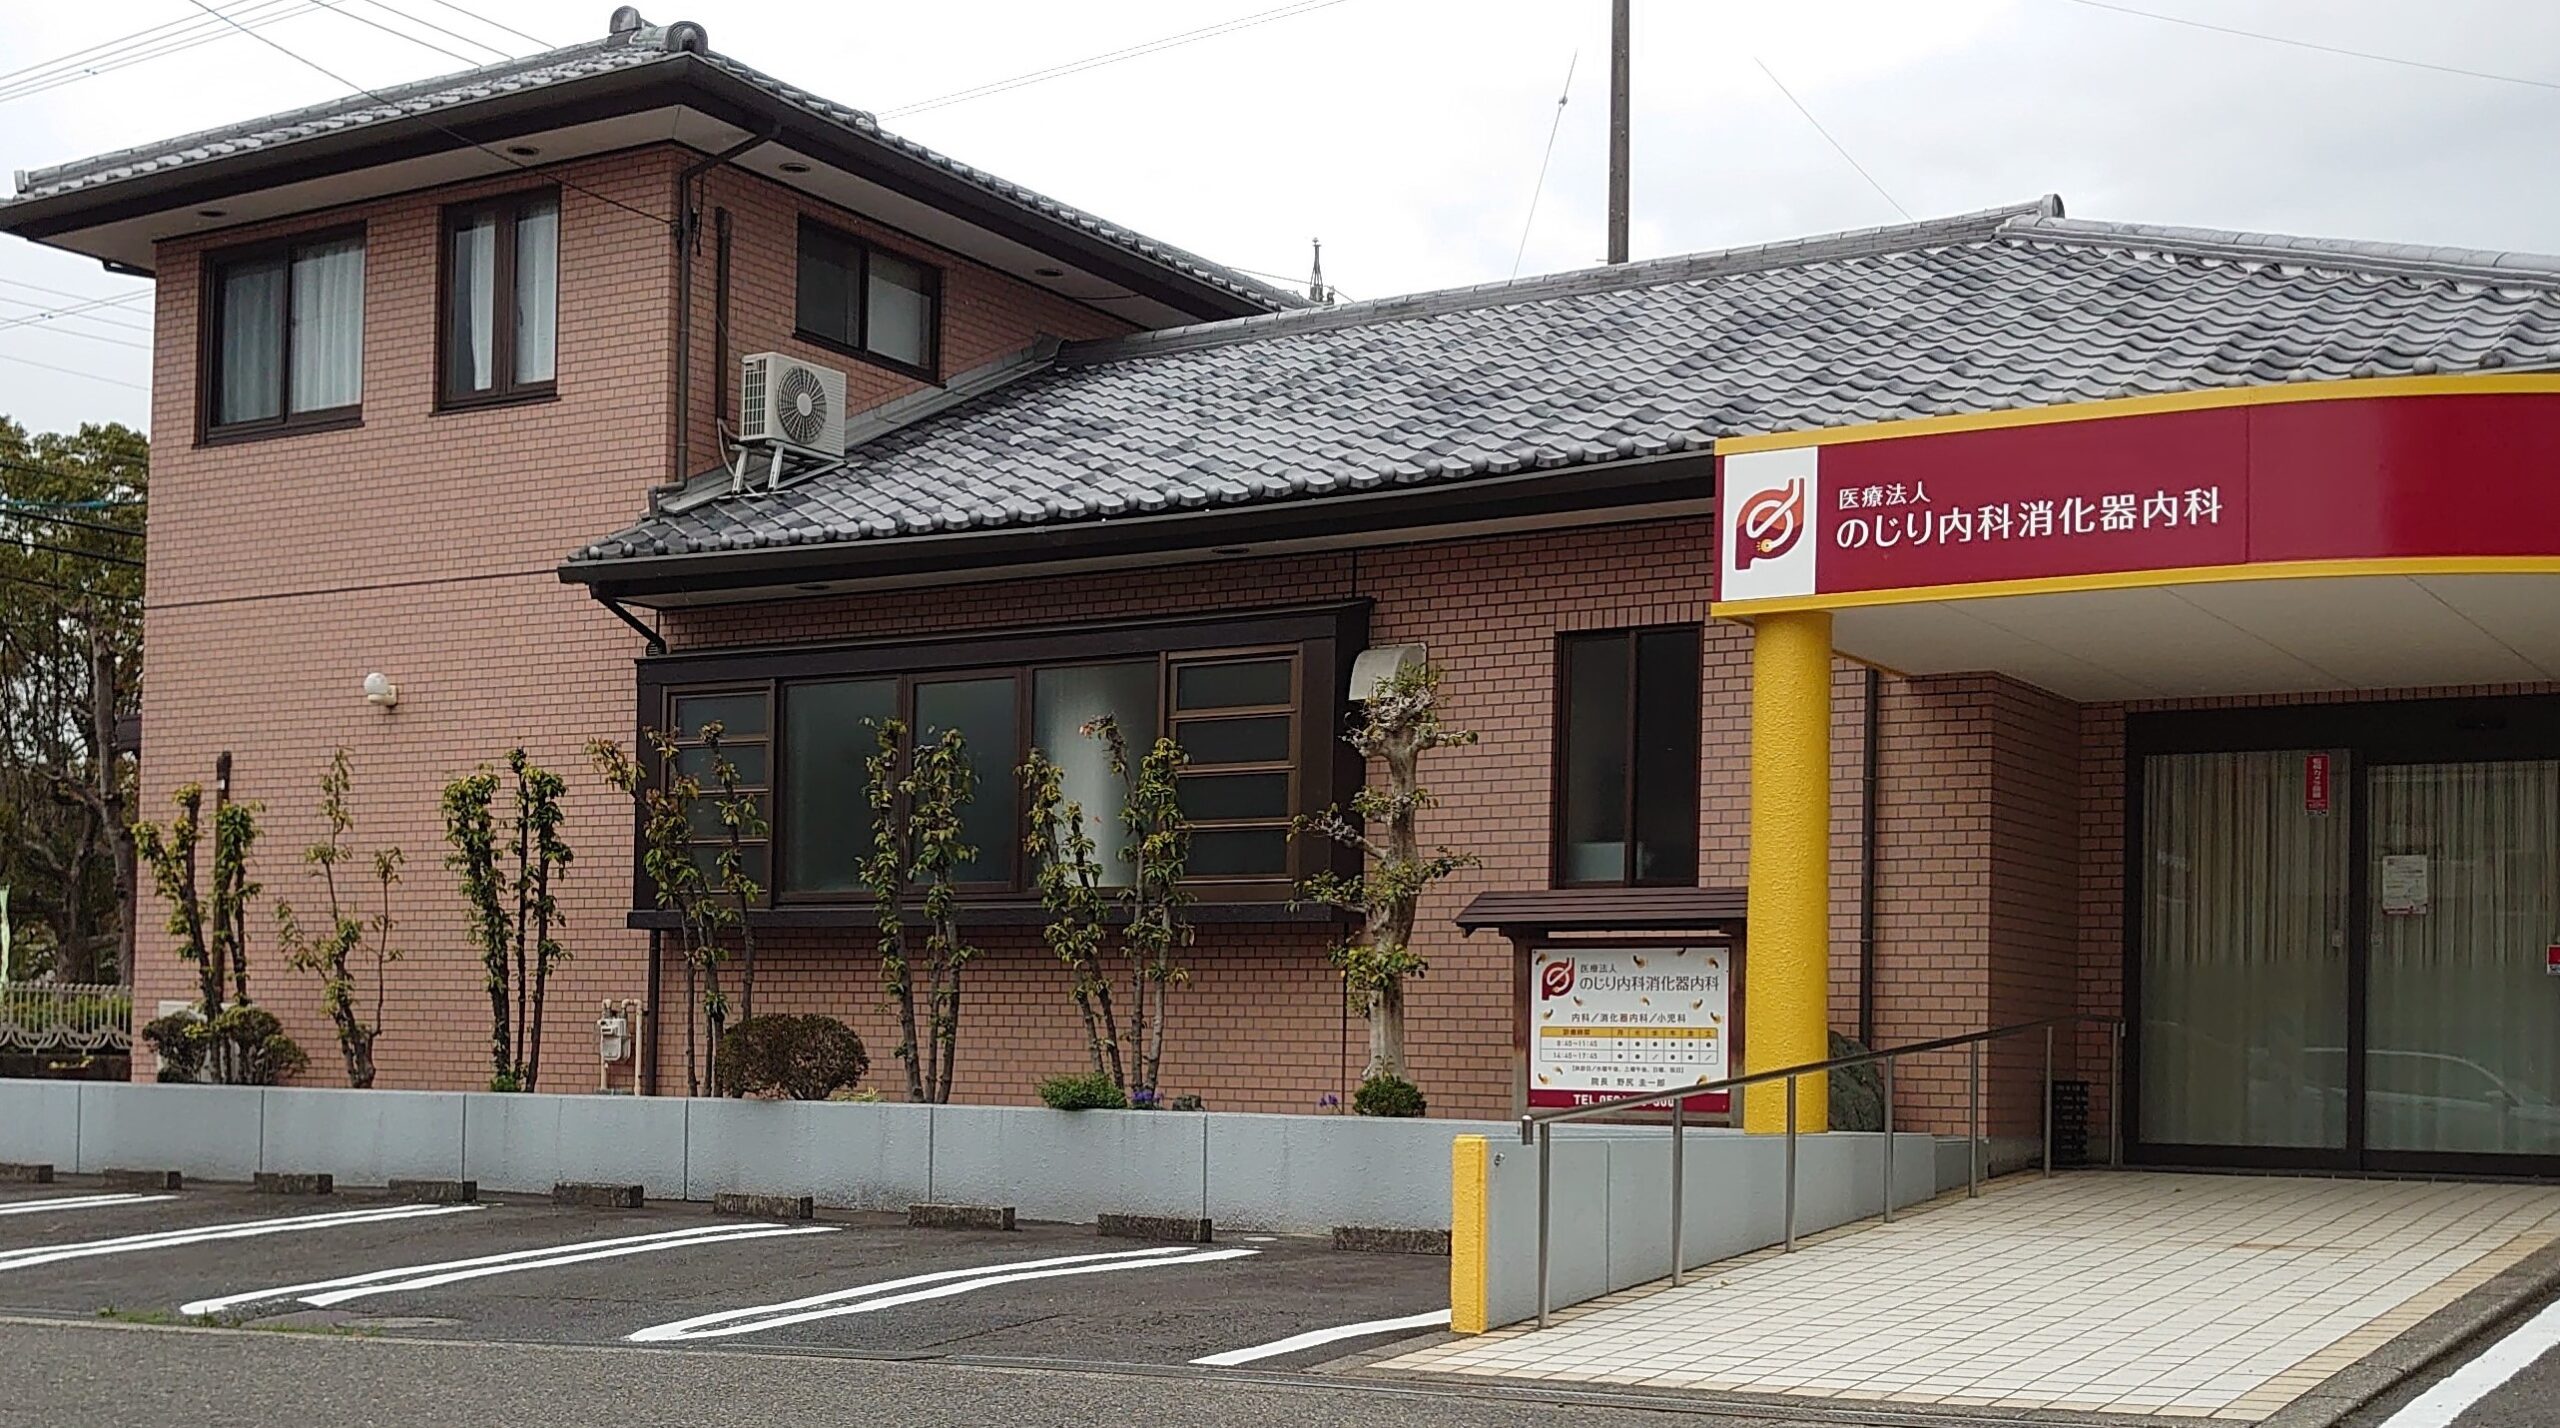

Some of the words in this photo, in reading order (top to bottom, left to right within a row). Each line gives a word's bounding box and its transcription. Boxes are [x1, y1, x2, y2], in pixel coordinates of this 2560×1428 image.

[1838, 480, 1931, 510] 医療法人
[1836, 486, 2223, 549] のじり内科消化器内科
[1580, 963, 1617, 973] 医療法人
[1579, 975, 1719, 992] のじり内科消化器内科
[1573, 1094, 1595, 1105] TEL
